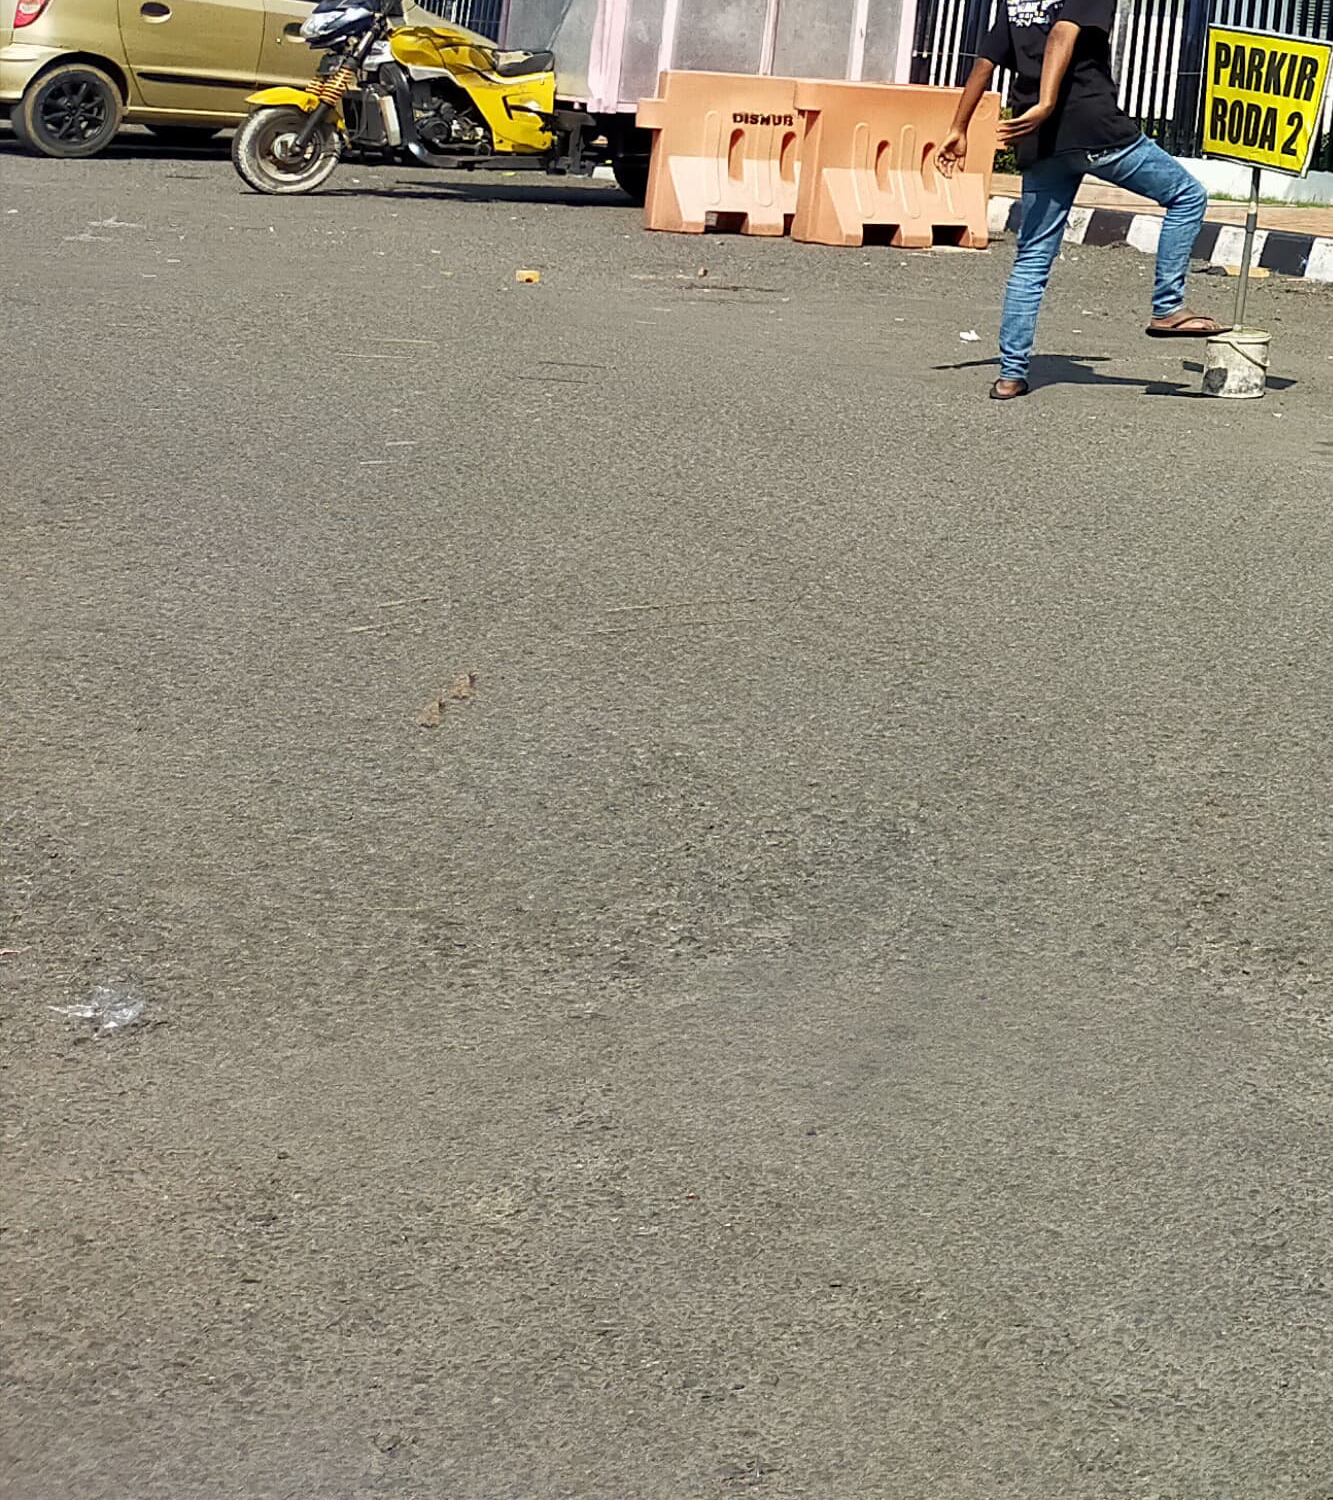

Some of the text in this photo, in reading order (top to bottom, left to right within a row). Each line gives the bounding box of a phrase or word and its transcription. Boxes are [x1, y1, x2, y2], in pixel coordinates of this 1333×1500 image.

[1213, 41, 1319, 102] PARKIR
[1210, 96, 1304, 156] RODA 2
